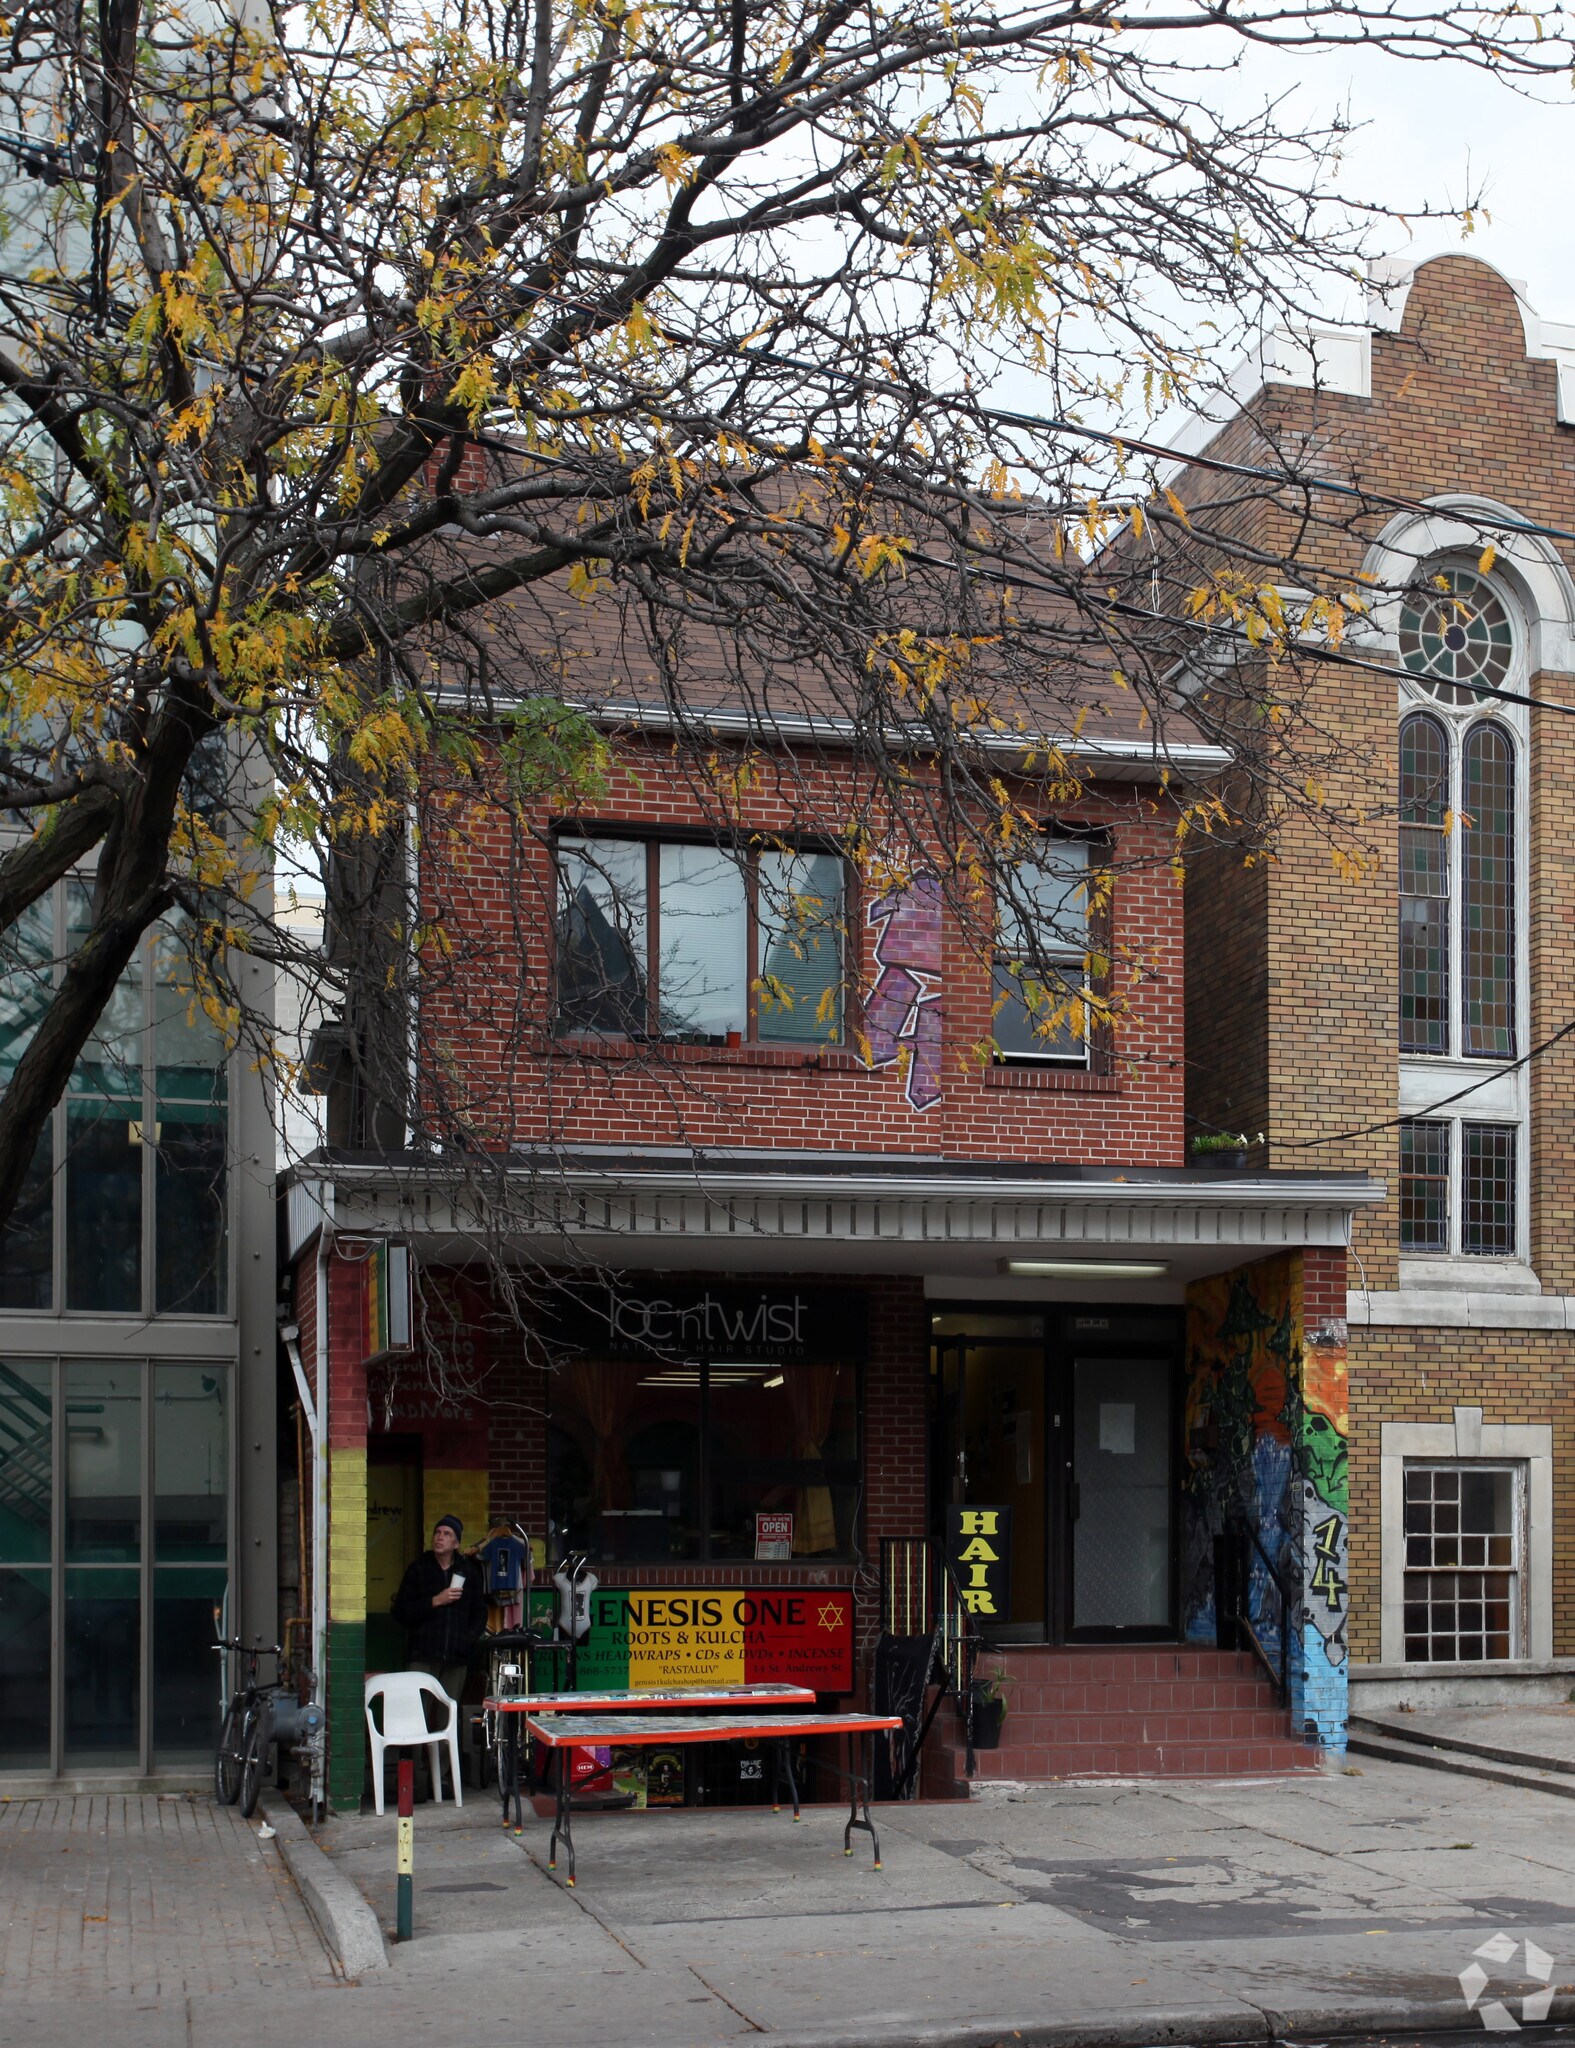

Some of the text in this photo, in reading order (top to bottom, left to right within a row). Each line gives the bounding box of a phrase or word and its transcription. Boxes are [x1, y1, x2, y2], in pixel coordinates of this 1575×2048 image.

[695, 1344, 735, 1354] HAIR
[744, 1345, 805, 1356] STUDIO
[367, 1500, 403, 1516] ndrew
[762, 1522, 788, 1533] OPEN
[957, 1510, 1000, 1614] HAIR
[589, 1598, 806, 1627] ENESIS ONE
[611, 1630, 767, 1645] ROOTS & KULCHA
[595, 1649, 682, 1662] HEADWRAPS
[695, 1648, 720, 1661] CDs
[724, 1648, 735, 1660] &
[739, 1648, 774, 1660] DVDs
[788, 1648, 846, 1660] INCENSE
[557, 1665, 630, 1677] -868-5737
[753, 1663, 765, 1673] 14
[785, 1662, 828, 1673] Andrews
